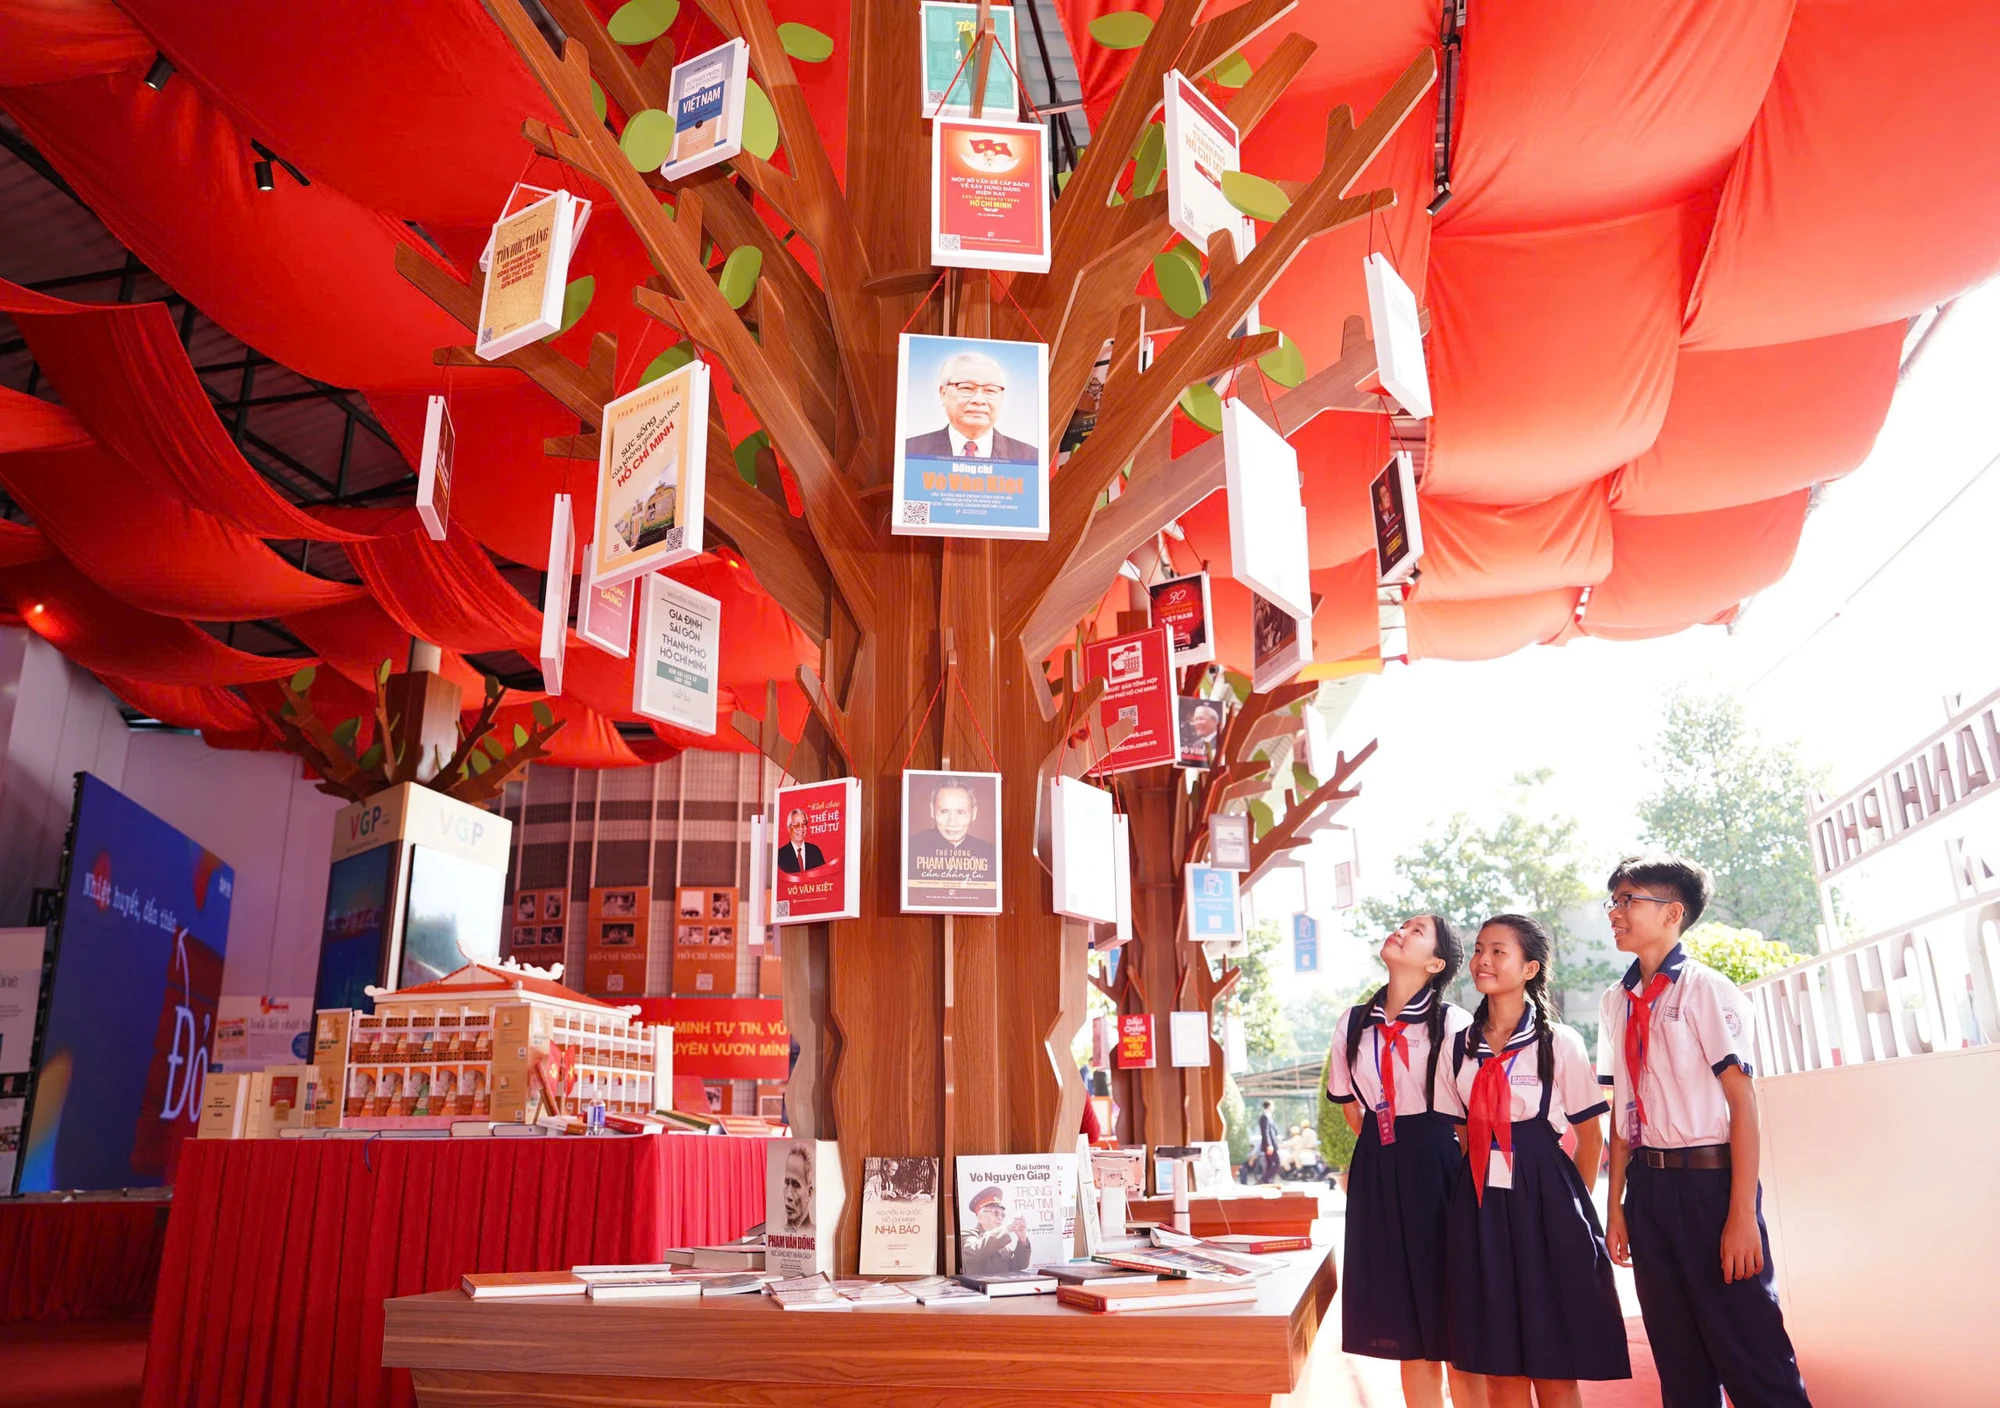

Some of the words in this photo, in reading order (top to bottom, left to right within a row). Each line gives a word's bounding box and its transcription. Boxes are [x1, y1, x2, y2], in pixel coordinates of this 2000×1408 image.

[683, 96, 701, 114] VIỆT
[701, 87, 720, 106] NAM
[621, 439, 636, 458] sức
[636, 415, 657, 440] sống
[611, 464, 623, 480] của
[622, 445, 643, 466] không
[641, 430, 656, 446] gian
[656, 416, 668, 430] văn
[617, 464, 632, 487] HỒ
[632, 446, 650, 470] CHÍ
[649, 420, 675, 452] MINH
[977, 464, 994, 474] chí
[923, 471, 947, 490] Võ
[948, 473, 984, 492] Văn
[986, 474, 1024, 495] Kiệt
[669, 609, 683, 622] GIA
[684, 615, 703, 630] ĐỊNH
[1177, 612, 1194, 620] NAM
[670, 622, 681, 634] SÀI
[682, 627, 701, 642] GÒN
[662, 633, 689, 652] THÀNH
[689, 643, 707, 659] PHỐ
[660, 646, 673, 659] HỒ
[673, 652, 688, 665] CHÍ
[688, 658, 707, 673] MINH
[350, 805, 382, 840] VGP
[810, 810, 827, 823] THẾ
[827, 811, 840, 821] HỆ
[440, 808, 484, 845] VGP
[810, 823, 827, 834] THỨ
[827, 822, 839, 832] TƯ
[916, 856, 944, 870] PHẠM
[944, 856, 962, 870] VĂN
[963, 856, 988, 871] ĐỒNG
[921, 868, 940, 877] của
[83, 871, 111, 906] Nhiệt
[787, 884, 798, 895] VÕ
[800, 883, 815, 894] VĂN
[816, 881, 834, 893] KIỆT
[620, 952, 644, 961] MINH
[676, 950, 690, 961] HỒ
[710, 951, 735, 961] MINH
[675, 1021, 711, 1034] MINH
[715, 1021, 736, 1037] TỰ
[739, 1022, 765, 1036] TIN,
[712, 1042, 756, 1056] VƯƠN
[1028, 1163, 1050, 1171] tướng
[969, 1172, 983, 1182] Võ
[1027, 1170, 1050, 1181] Giáp
[1015, 1185, 1052, 1197] TRONG
[875, 1223, 897, 1234] NHÀ
[899, 1222, 920, 1234] BÁO
[768, 1234, 784, 1248] PHẠM
[785, 1234, 797, 1249] VĂN
[798, 1234, 815, 1250] ĐỒNG
